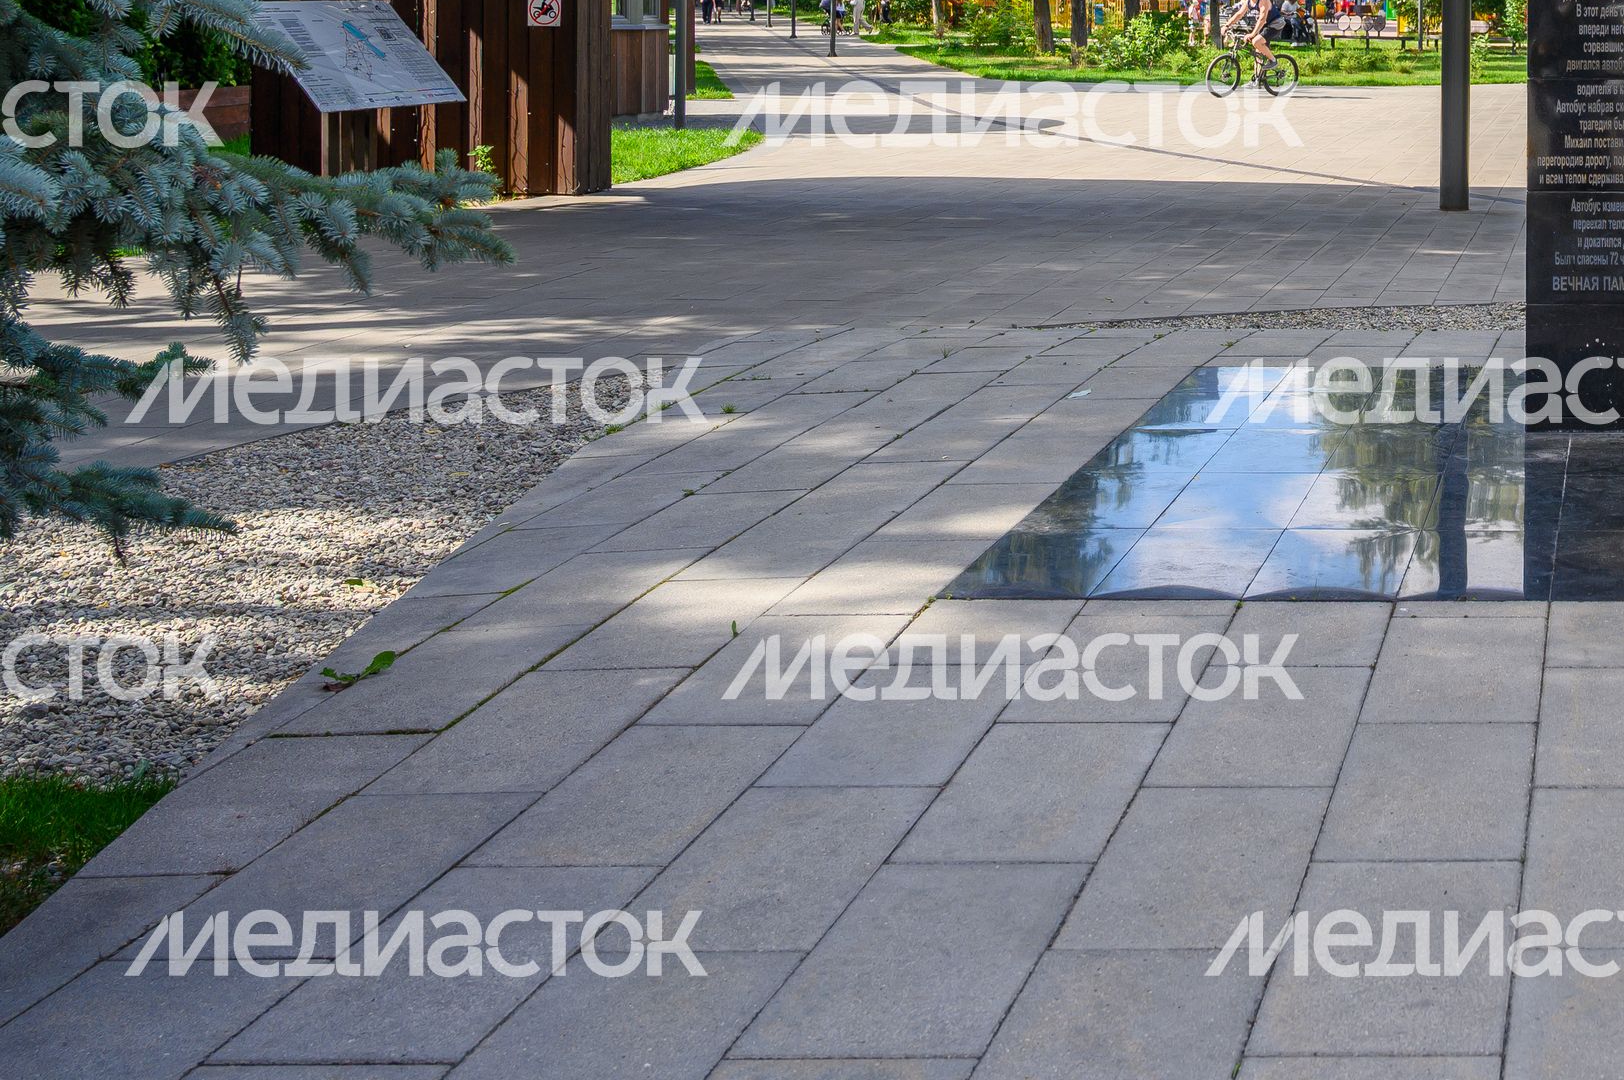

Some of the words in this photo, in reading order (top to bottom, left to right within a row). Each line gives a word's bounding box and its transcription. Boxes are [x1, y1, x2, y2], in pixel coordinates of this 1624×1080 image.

[1576, 4, 1582, 17] В
[1583, 6, 1599, 17] этот
[1600, 5, 1618, 19] день
[1578, 24, 1610, 38] впереди
[1566, 59, 1600, 72] двигался
[1556, 99, 1586, 116] Автобус
[1587, 100, 1614, 115] набрав
[1579, 120, 1612, 132] трагедия
[1564, 135, 1592, 149] Михаил
[1537, 155, 1584, 170] перегородив
[1539, 173, 1544, 184] и
[1545, 173, 1563, 184] всем
[1564, 173, 1587, 184] телом
[1570, 198, 1601, 215] Автобус
[1608, 219, 1624, 230] тело
[1583, 237, 1622, 249] докатился
[1577, 254, 1609, 265] спасены
[1609, 252, 1619, 265] 72
[1552, 275, 1599, 292] ВЕЧНАЯ
